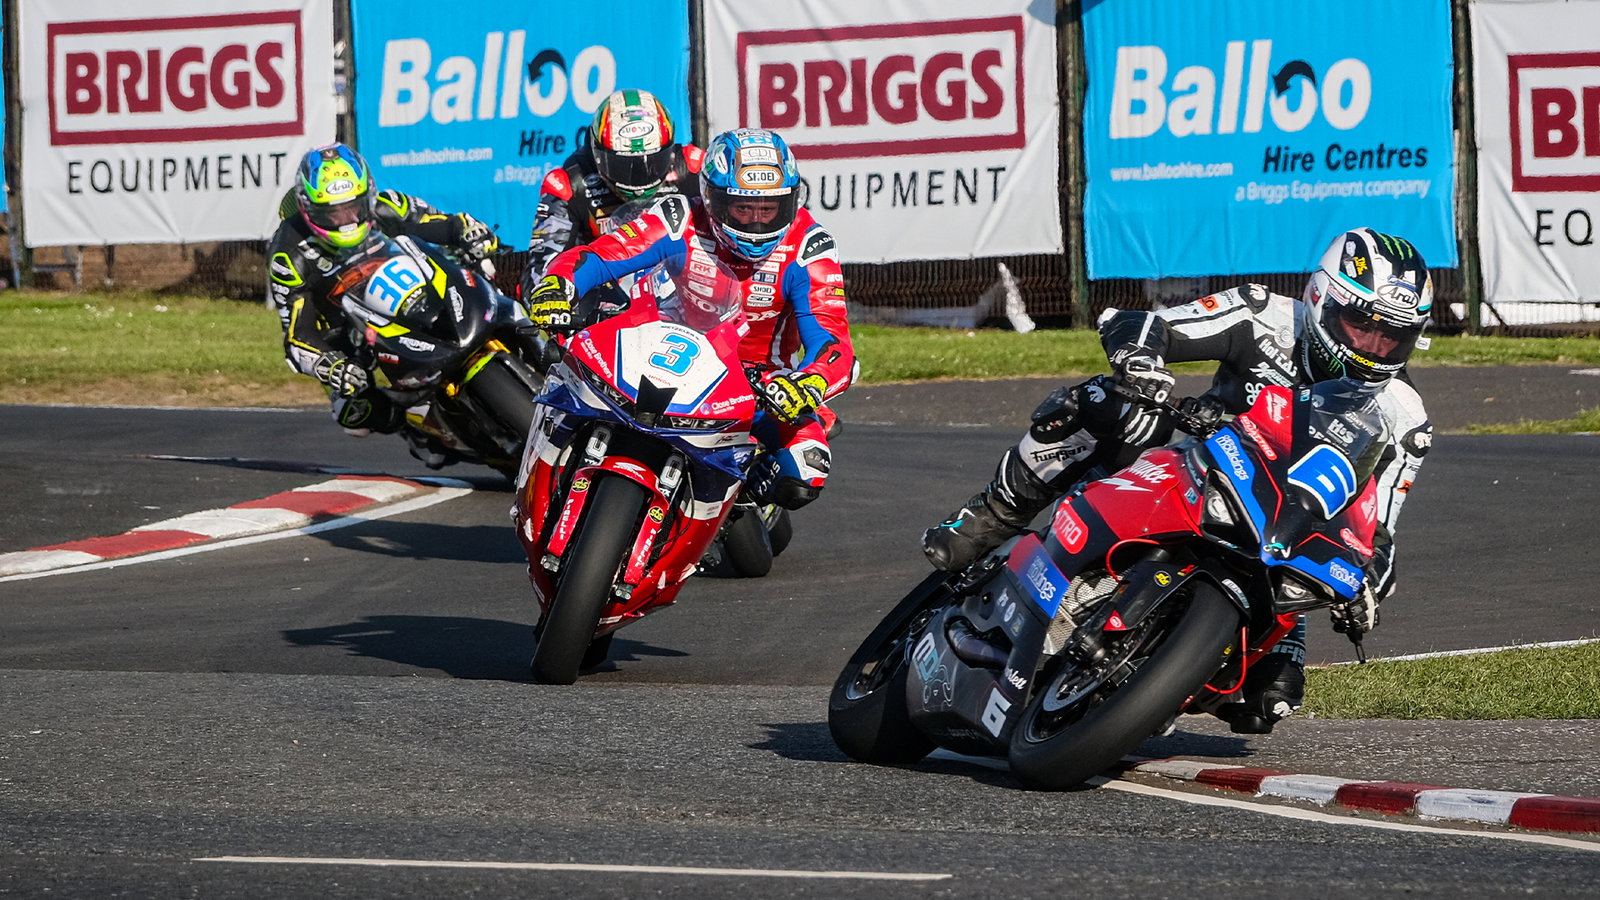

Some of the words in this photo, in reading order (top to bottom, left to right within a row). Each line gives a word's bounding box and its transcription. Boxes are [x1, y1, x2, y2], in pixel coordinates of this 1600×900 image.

[66, 41, 284, 114] BRIGGS
[378, 30, 617, 127] Balloo
[758, 48, 1004, 129] BRIGGS
[1109, 39, 1372, 139] Balloo
[380, 147, 494, 167] www.balloohire.com
[519, 130, 566, 156] Hire
[1262, 145, 1315, 173] Hire
[1325, 142, 1429, 171] Centres
[68, 152, 287, 194] EQUIPMENT
[503, 165, 541, 186] Briggs
[800, 167, 1007, 211] QUIPMENT
[1110, 161, 1234, 182] www.balloohire.com
[1235, 186, 1246, 201] a
[1246, 181, 1291, 205] Briggs
[1291, 178, 1364, 201] Equipment
[1365, 177, 1432, 200] company
[368, 260, 420, 312] 36
[648, 331, 702, 377] 3
[1030, 445, 1086, 462] Furygan
[1285, 442, 1357, 521] 6
[559, 498, 575, 541] PIRELLI
[981, 687, 1013, 738] 6
